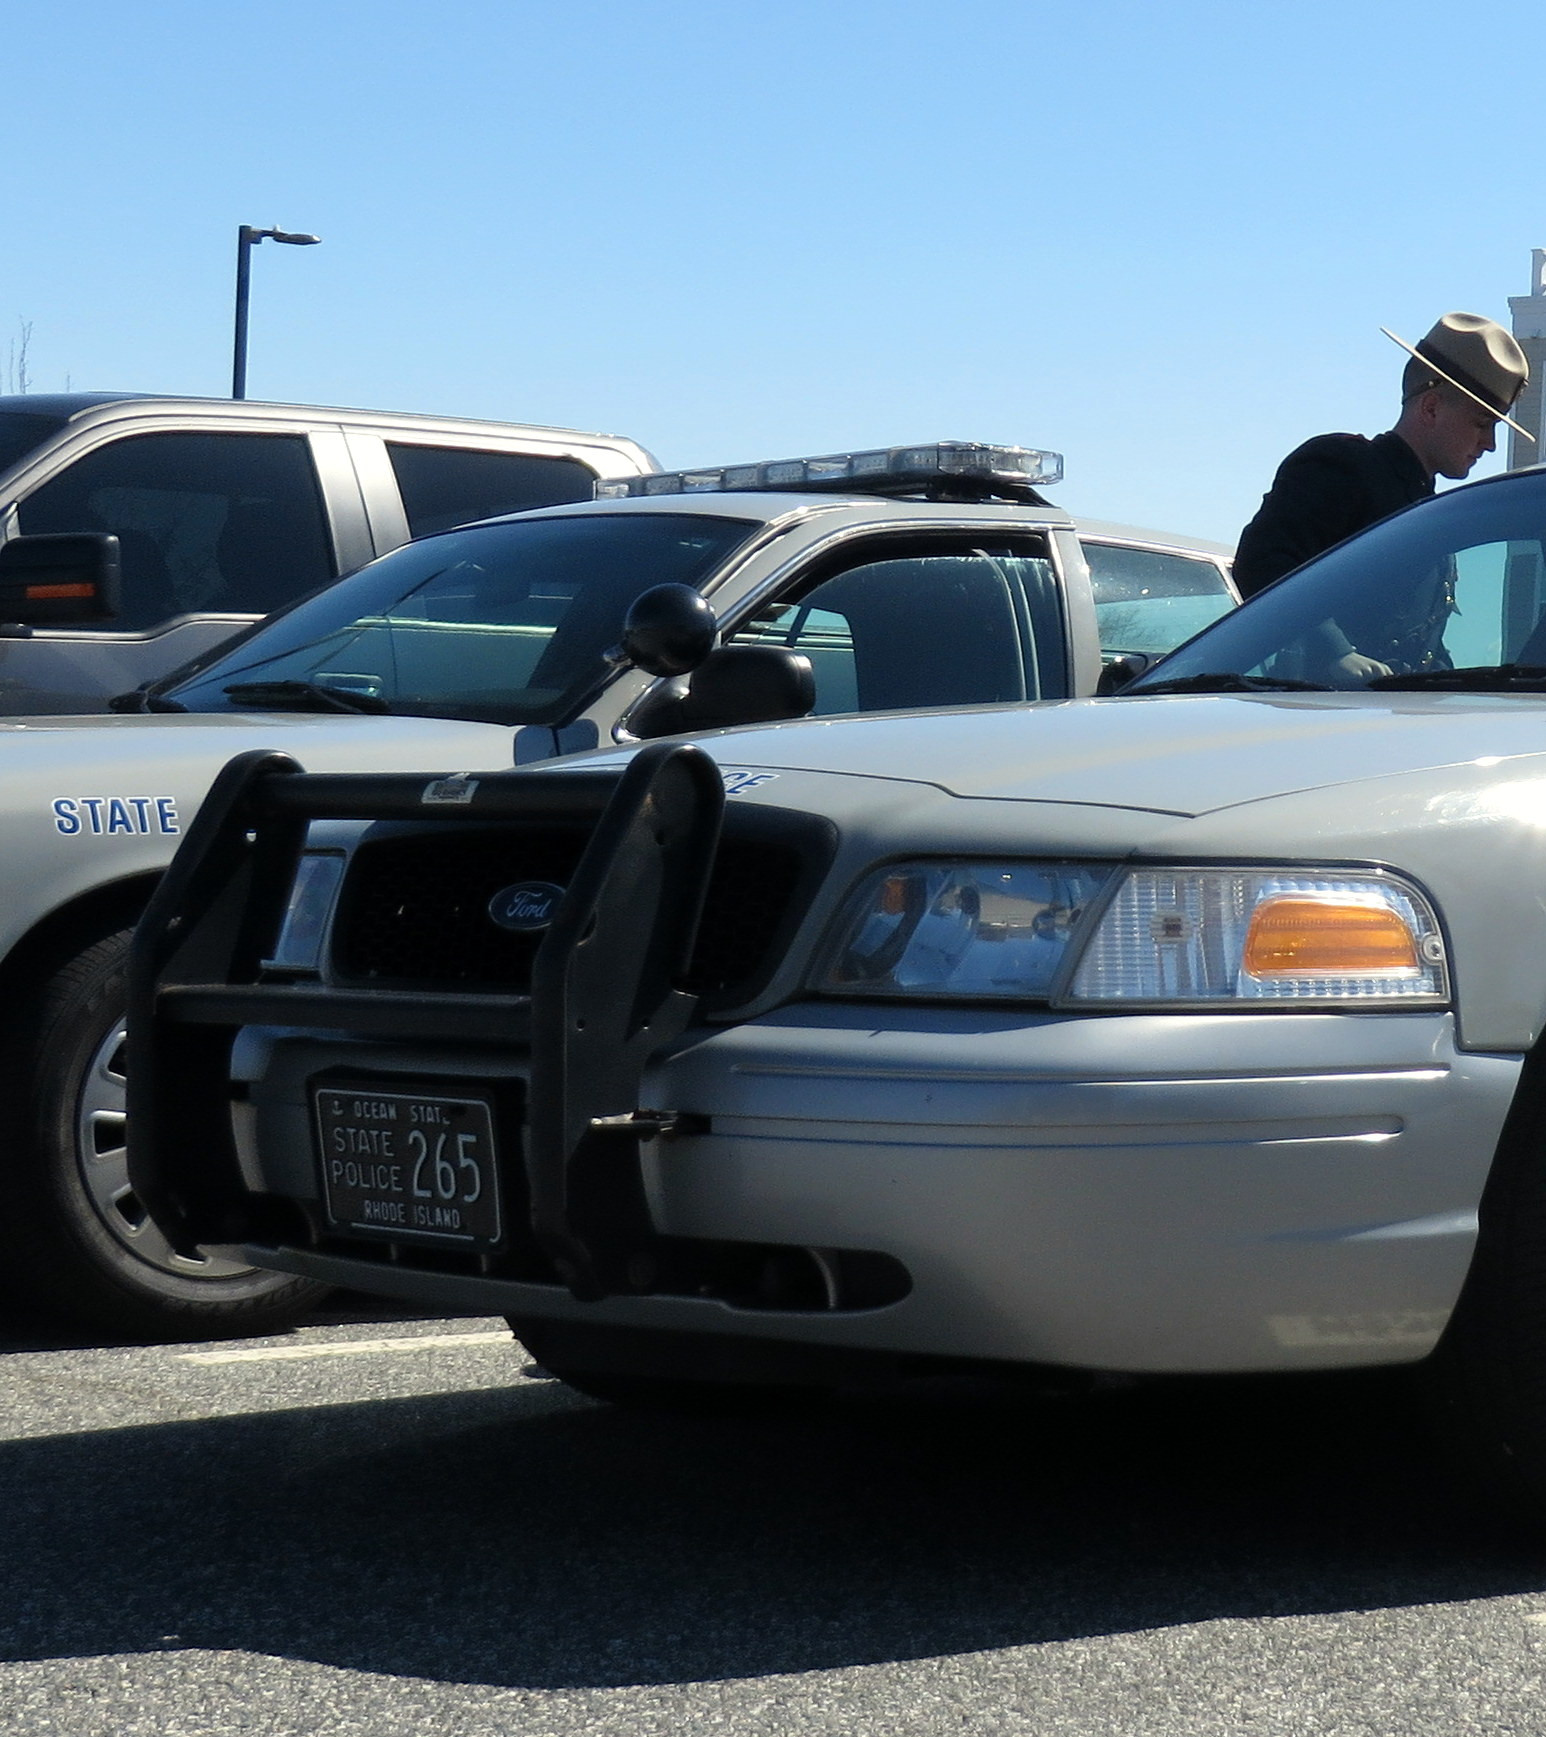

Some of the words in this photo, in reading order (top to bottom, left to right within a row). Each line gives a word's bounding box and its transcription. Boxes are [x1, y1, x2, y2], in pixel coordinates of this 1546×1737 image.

[51, 796, 180, 835] STATE
[506, 890, 553, 918] Ford
[353, 1101, 398, 1121] OCEAN
[332, 1127, 395, 1157] STATE
[331, 1159, 404, 1191] POLICE
[408, 1129, 481, 1204] 265
[364, 1200, 406, 1223] RHODE
[414, 1205, 461, 1229] ISLAND
